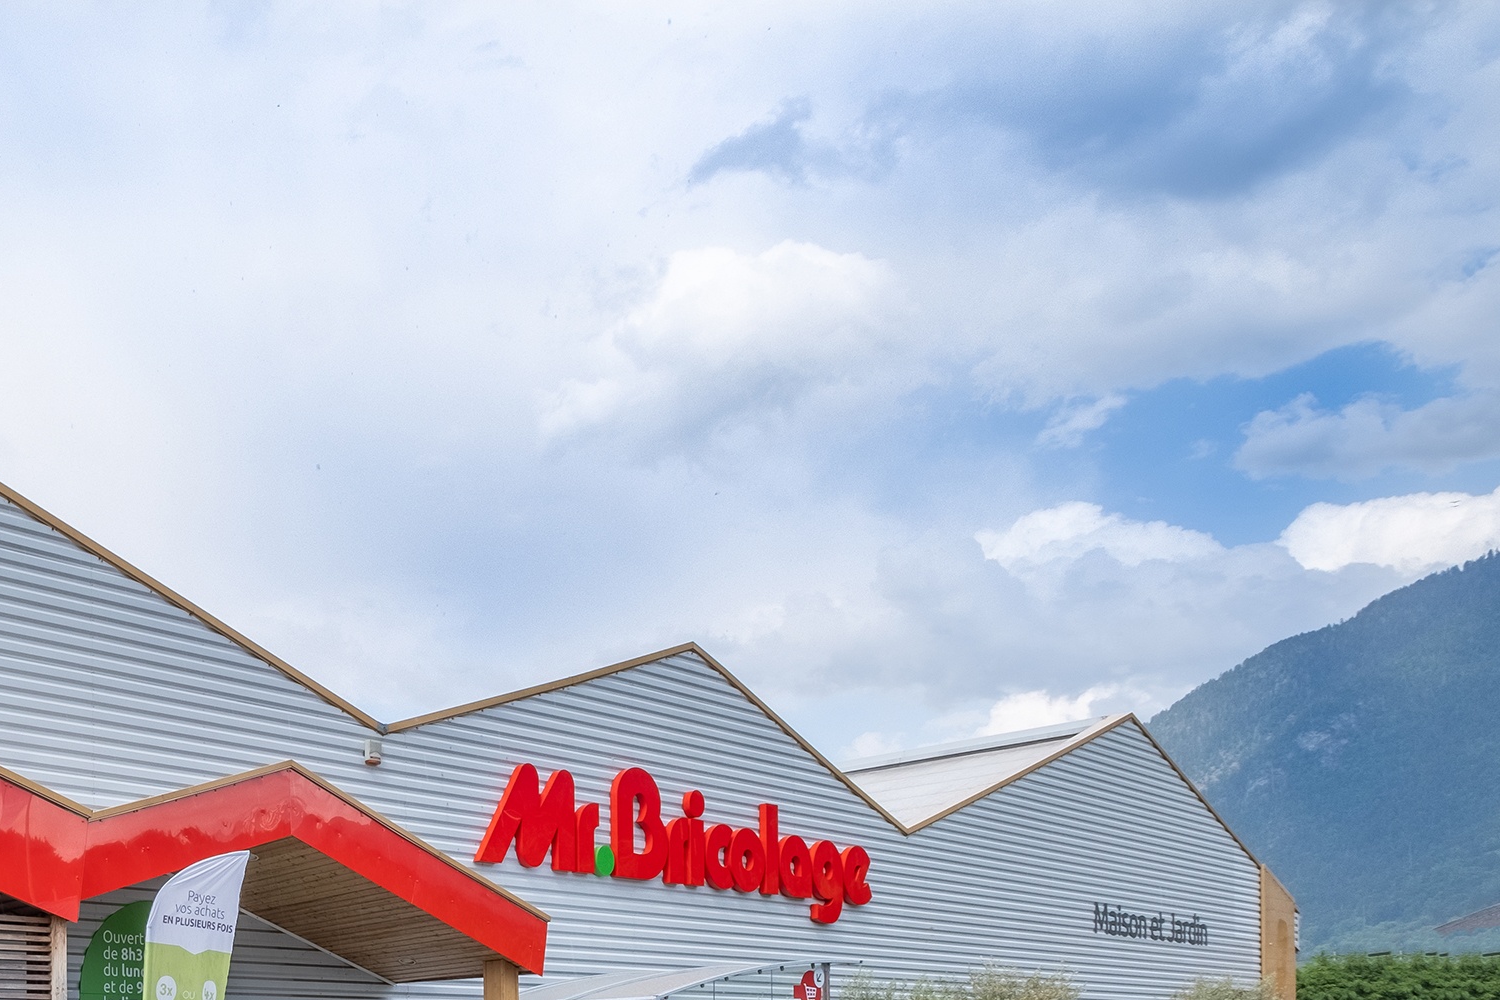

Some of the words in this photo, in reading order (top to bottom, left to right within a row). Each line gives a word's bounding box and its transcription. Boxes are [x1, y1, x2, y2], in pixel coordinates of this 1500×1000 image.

[187, 890, 216, 907] Payez
[175, 904, 192, 915] vos
[194, 905, 225, 920] achats
[163, 915, 174, 925] EN
[175, 917, 216, 931] PLUSIEURS
[217, 922, 233, 934] FOIS
[1093, 901, 1147, 939] Maison
[1150, 912, 1166, 941] et
[1167, 912, 1208, 946] Jardin
[103, 930, 144, 945] Ouvert
[103, 946, 118, 960] de
[121, 947, 143, 961] 8h3
[103, 963, 118, 977] du
[103, 981, 116, 993] et
[119, 980, 134, 994] de
[159, 983, 173, 997] 3x
